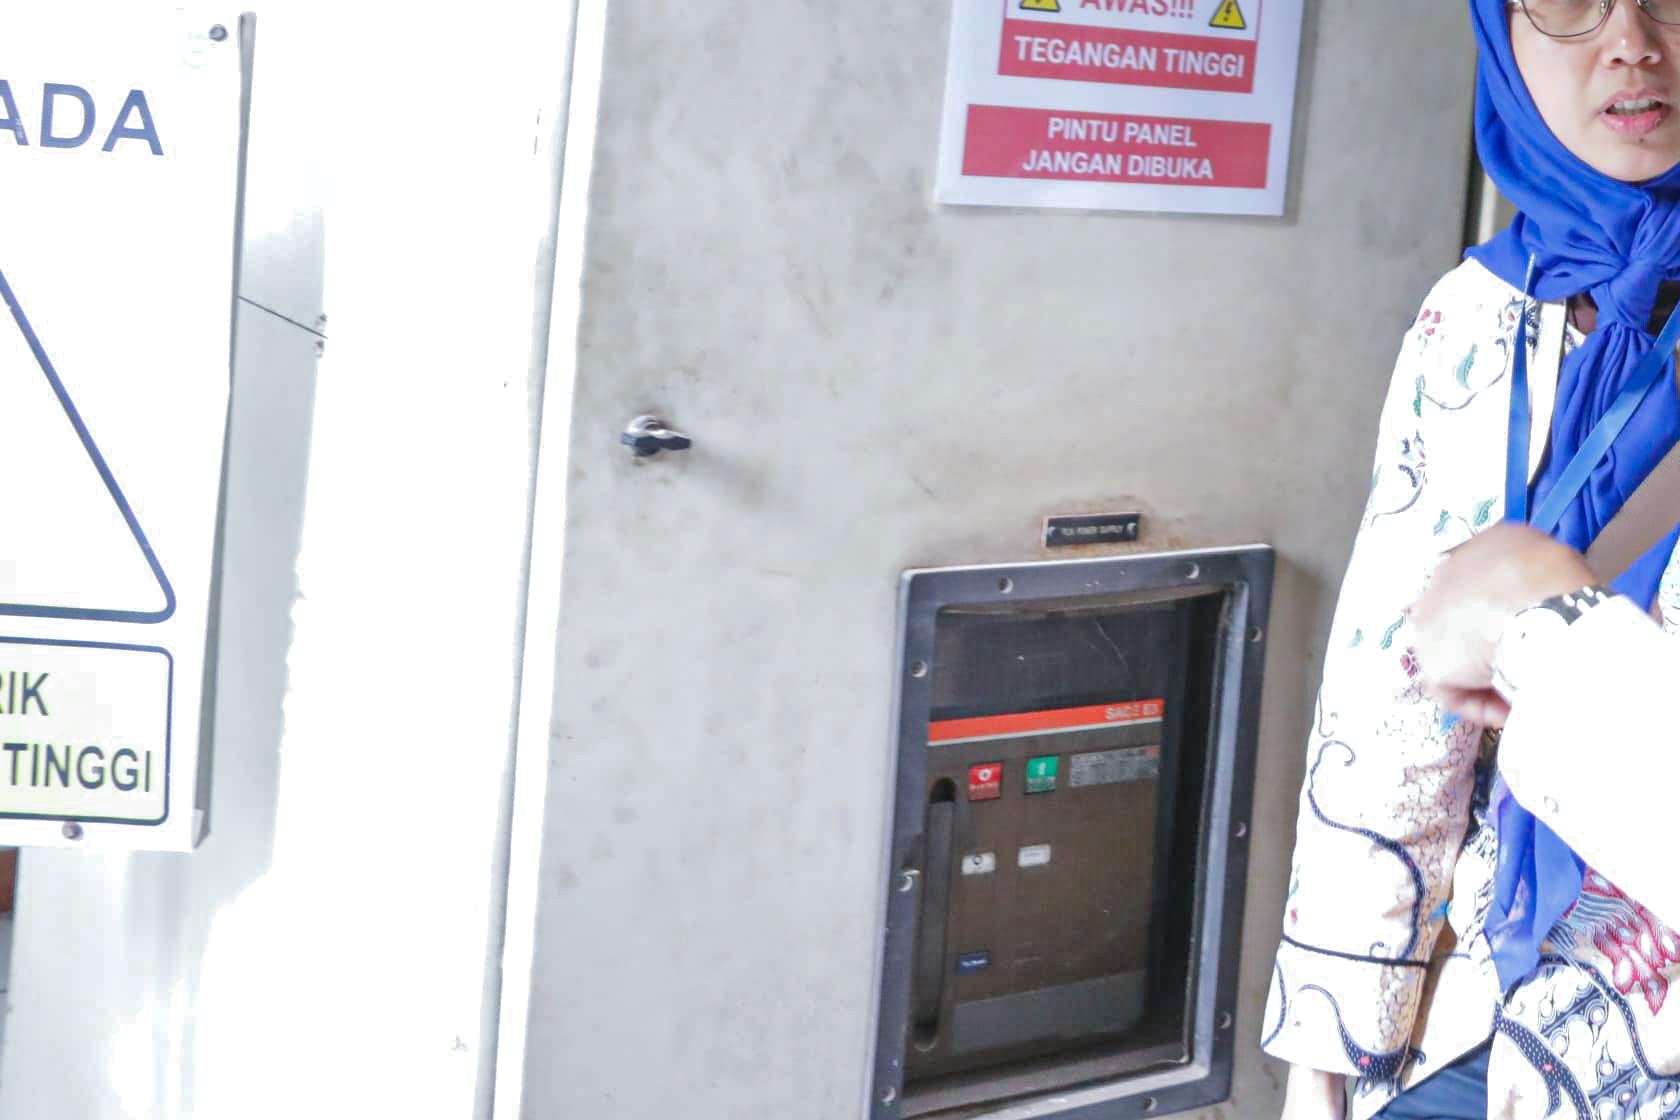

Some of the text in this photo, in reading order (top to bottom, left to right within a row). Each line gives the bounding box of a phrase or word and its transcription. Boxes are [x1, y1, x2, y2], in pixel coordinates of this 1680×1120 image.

[1014, 34, 1246, 78] TEGANGAN TINGGI
[1047, 116, 1197, 147] PINTU PANEL
[1022, 149, 1214, 180] JANGAN DIBUKA
[3, 742, 152, 793] TINGGI
